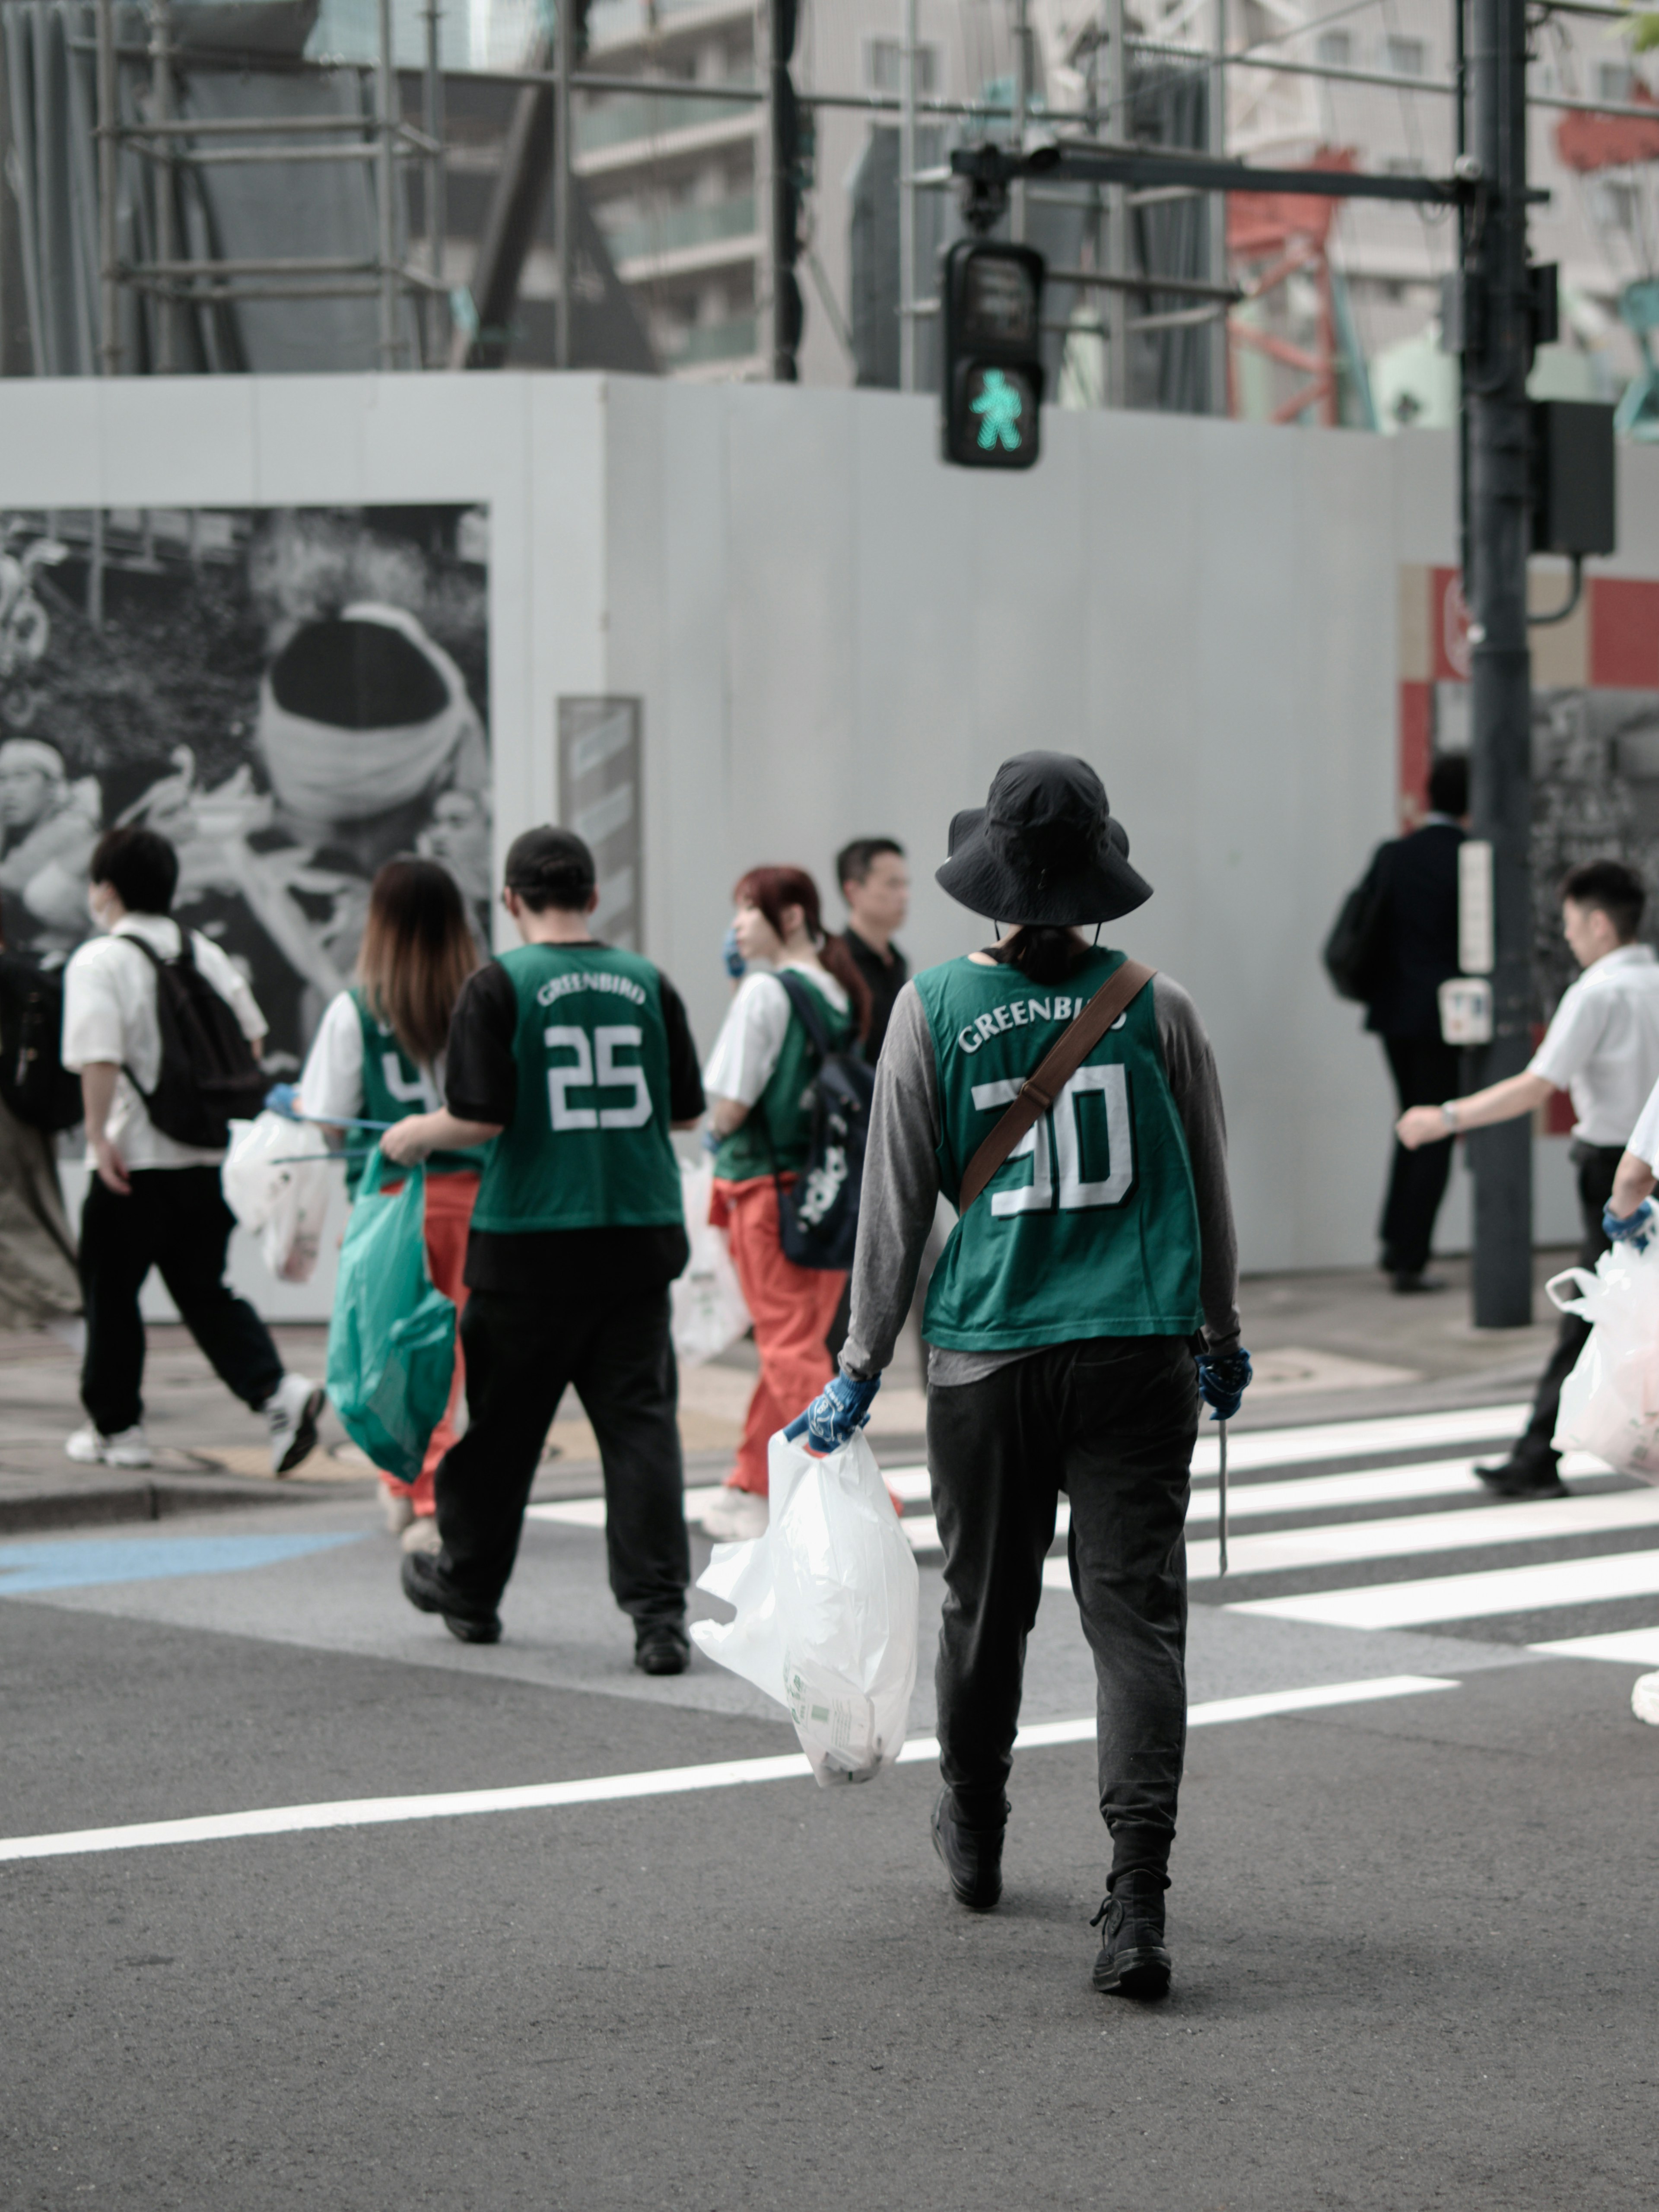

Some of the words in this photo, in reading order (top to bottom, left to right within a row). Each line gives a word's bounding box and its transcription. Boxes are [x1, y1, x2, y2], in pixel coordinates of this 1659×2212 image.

[537, 972, 646, 1007] GREENBIRD
[958, 996, 1128, 1054] GREENBI
[544, 1024, 653, 1131] 25
[971, 1063, 1133, 1216] 30
